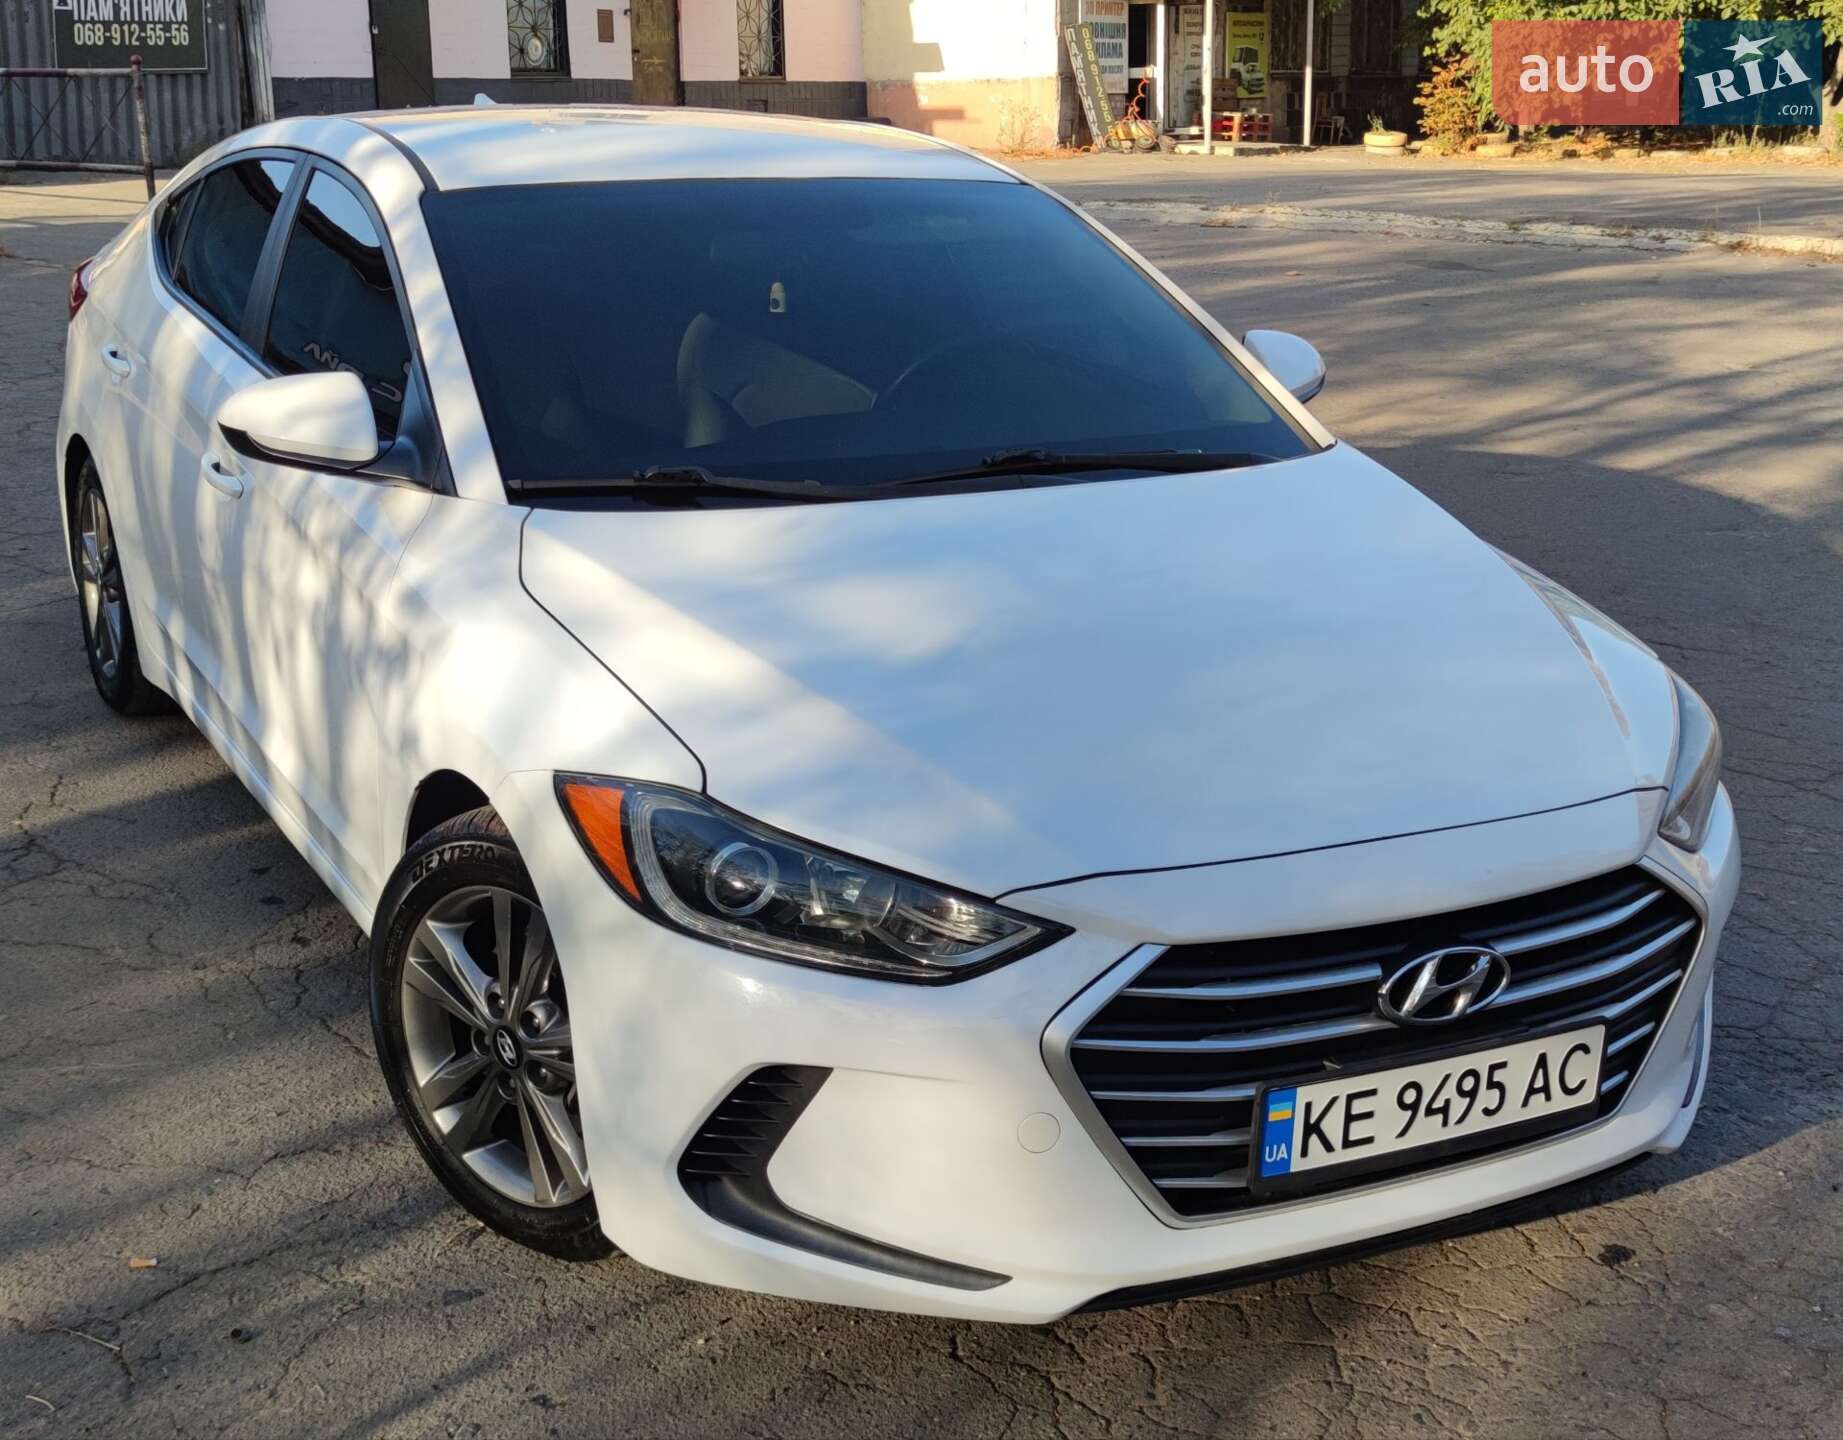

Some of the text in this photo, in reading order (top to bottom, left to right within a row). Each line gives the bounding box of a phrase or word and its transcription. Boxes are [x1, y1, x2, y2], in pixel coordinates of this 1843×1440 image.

[73, 23, 189, 46] 068-912-55-56
[1084, 22, 1126, 40] ОВНІШНЯ
[1300, 1042, 1592, 1158] KE 9495 AC
[1264, 1143, 1288, 1163] UA
